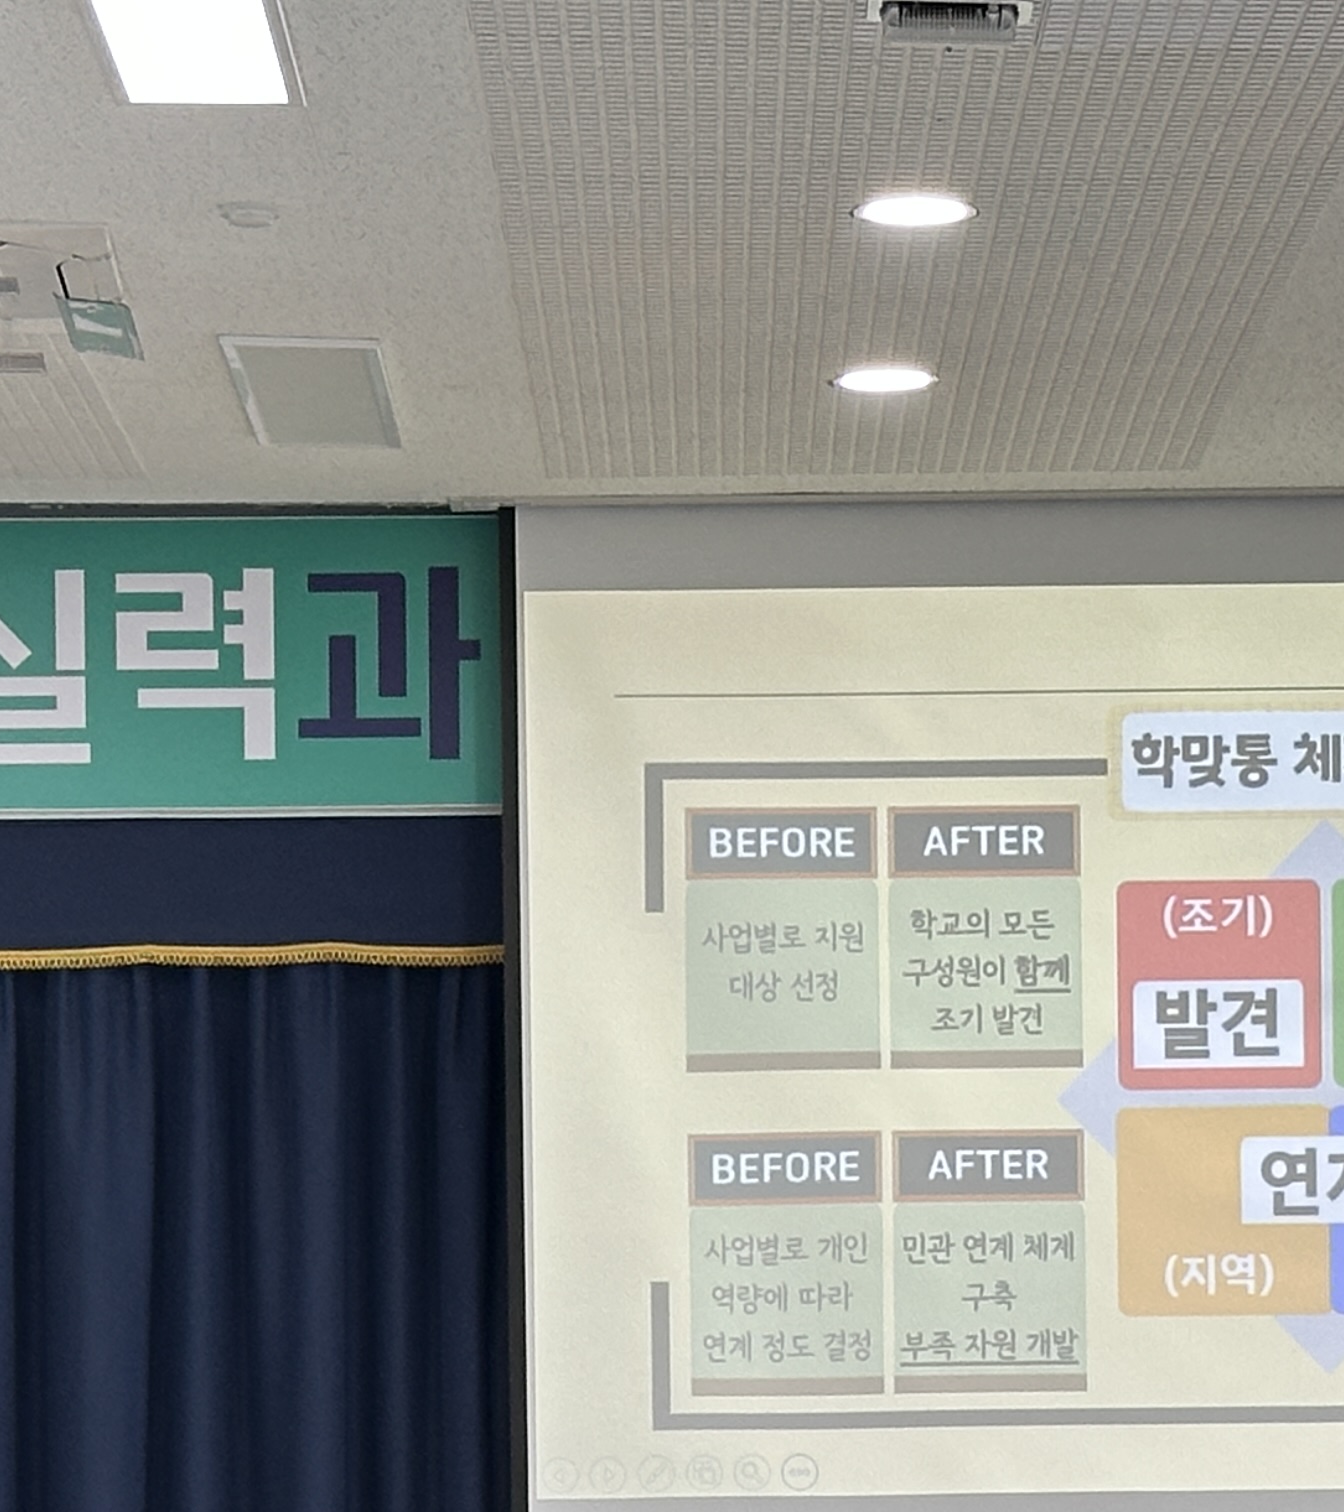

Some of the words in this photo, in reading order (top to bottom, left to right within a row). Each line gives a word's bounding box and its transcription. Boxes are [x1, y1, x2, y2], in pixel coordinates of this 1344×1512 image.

[1131, 732, 1278, 789] 학맞통
[709, 827, 855, 857] BEFORE
[923, 825, 1045, 856] AFTER
[910, 909, 990, 939] 학교의
[999, 909, 1054, 939] 모든
[1163, 894, 1273, 938] (조기)
[702, 922, 805, 954] 사업별로
[816, 922, 864, 953] 지원
[729, 971, 781, 1002] 대상
[791, 970, 838, 1002] 선정
[903, 955, 1006, 987] 구성원이
[1015, 955, 1071, 986] 함께
[931, 1004, 983, 1034] 조기
[993, 1003, 1043, 1035] 발견
[1156, 988, 1280, 1059] 발견
[711, 1152, 860, 1184] BEFORE
[928, 1149, 1049, 1181] AFTER
[704, 1233, 809, 1266] 사업별로
[818, 1232, 868, 1264] 개인
[902, 1233, 955, 1265] 민관
[963, 1232, 1013, 1264] 연계
[1023, 1231, 1075, 1262] 체계
[1165, 1252, 1275, 1296] (지역)
[712, 1281, 789, 1315] 역량에
[799, 1281, 853, 1313] 따라
[961, 1280, 1017, 1312] 구축
[703, 1332, 752, 1363] 연계
[763, 1332, 814, 1362] 정도
[824, 1330, 872, 1361] 결정
[900, 1331, 956, 1361] 부족
[965, 1329, 1017, 1360] 자원
[1027, 1327, 1079, 1360] 개발
